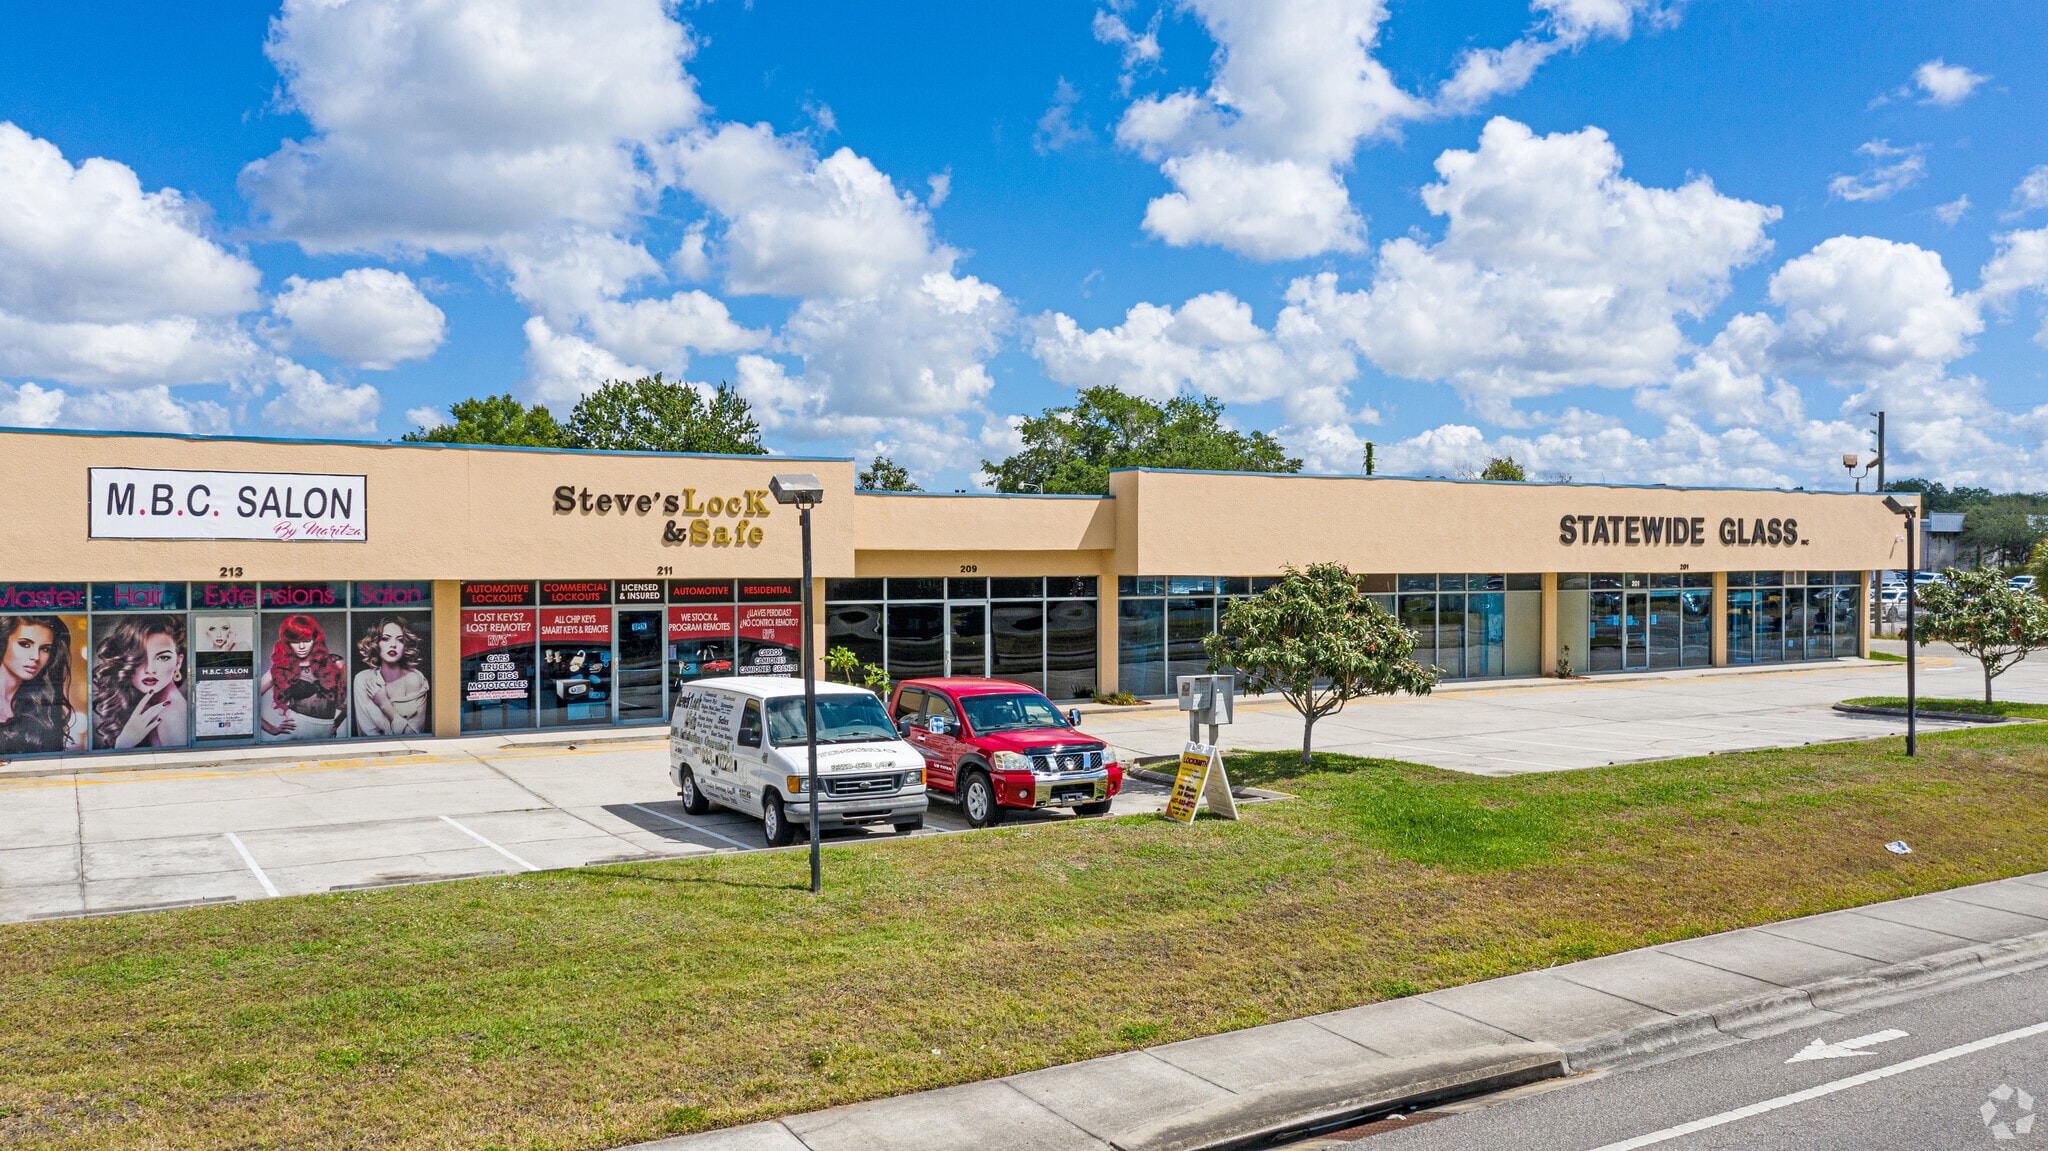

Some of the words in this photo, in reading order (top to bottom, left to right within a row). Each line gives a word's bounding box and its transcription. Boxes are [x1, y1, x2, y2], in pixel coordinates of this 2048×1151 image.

[107, 482, 219, 516] M.B.C.
[237, 486, 352, 519] SALON
[554, 486, 680, 512] Steve's
[274, 520, 296, 540] By
[302, 521, 362, 538] Maritza
[664, 520, 686, 542] &
[690, 518, 764, 544] Safe
[1560, 514, 1705, 545] STATEWIDE
[1720, 517, 1798, 545] GLASS
[220, 566, 243, 578] 213
[656, 566, 673, 576] 211
[960, 564, 978, 573] 209
[466, 584, 528, 592] AUTOMOTIVE
[544, 584, 608, 592] COMMERCIAL
[673, 587, 728, 595] AUTOMOTIVE
[114, 586, 163, 606] Hair
[204, 585, 336, 605] Extensions
[360, 584, 422, 604] Salon
[472, 594, 523, 603] LOCKOUTS
[552, 592, 600, 601] LOCKOUTS
[474, 613, 496, 622] LOST
[497, 612, 524, 621] KEYS?
[554, 615, 566, 624] ALL
[566, 615, 580, 623] CHIP
[581, 615, 596, 623] KEYS
[466, 623, 488, 632] LOST
[490, 622, 531, 632] REMOTE?
[542, 626, 562, 634] SMART
[564, 626, 578, 634] KEYS
[584, 625, 609, 633] REMOTE
[668, 624, 701, 632] PROGRAM
[703, 623, 730, 631] REMOTES
[486, 654, 510, 662] CARS
[480, 662, 515, 671] TRUCKS
[772, 664, 798, 672] GRANDE
[478, 672, 495, 680] BIG
[498, 671, 519, 680] RIGS
[468, 680, 528, 690] MOTOTCYCLES
